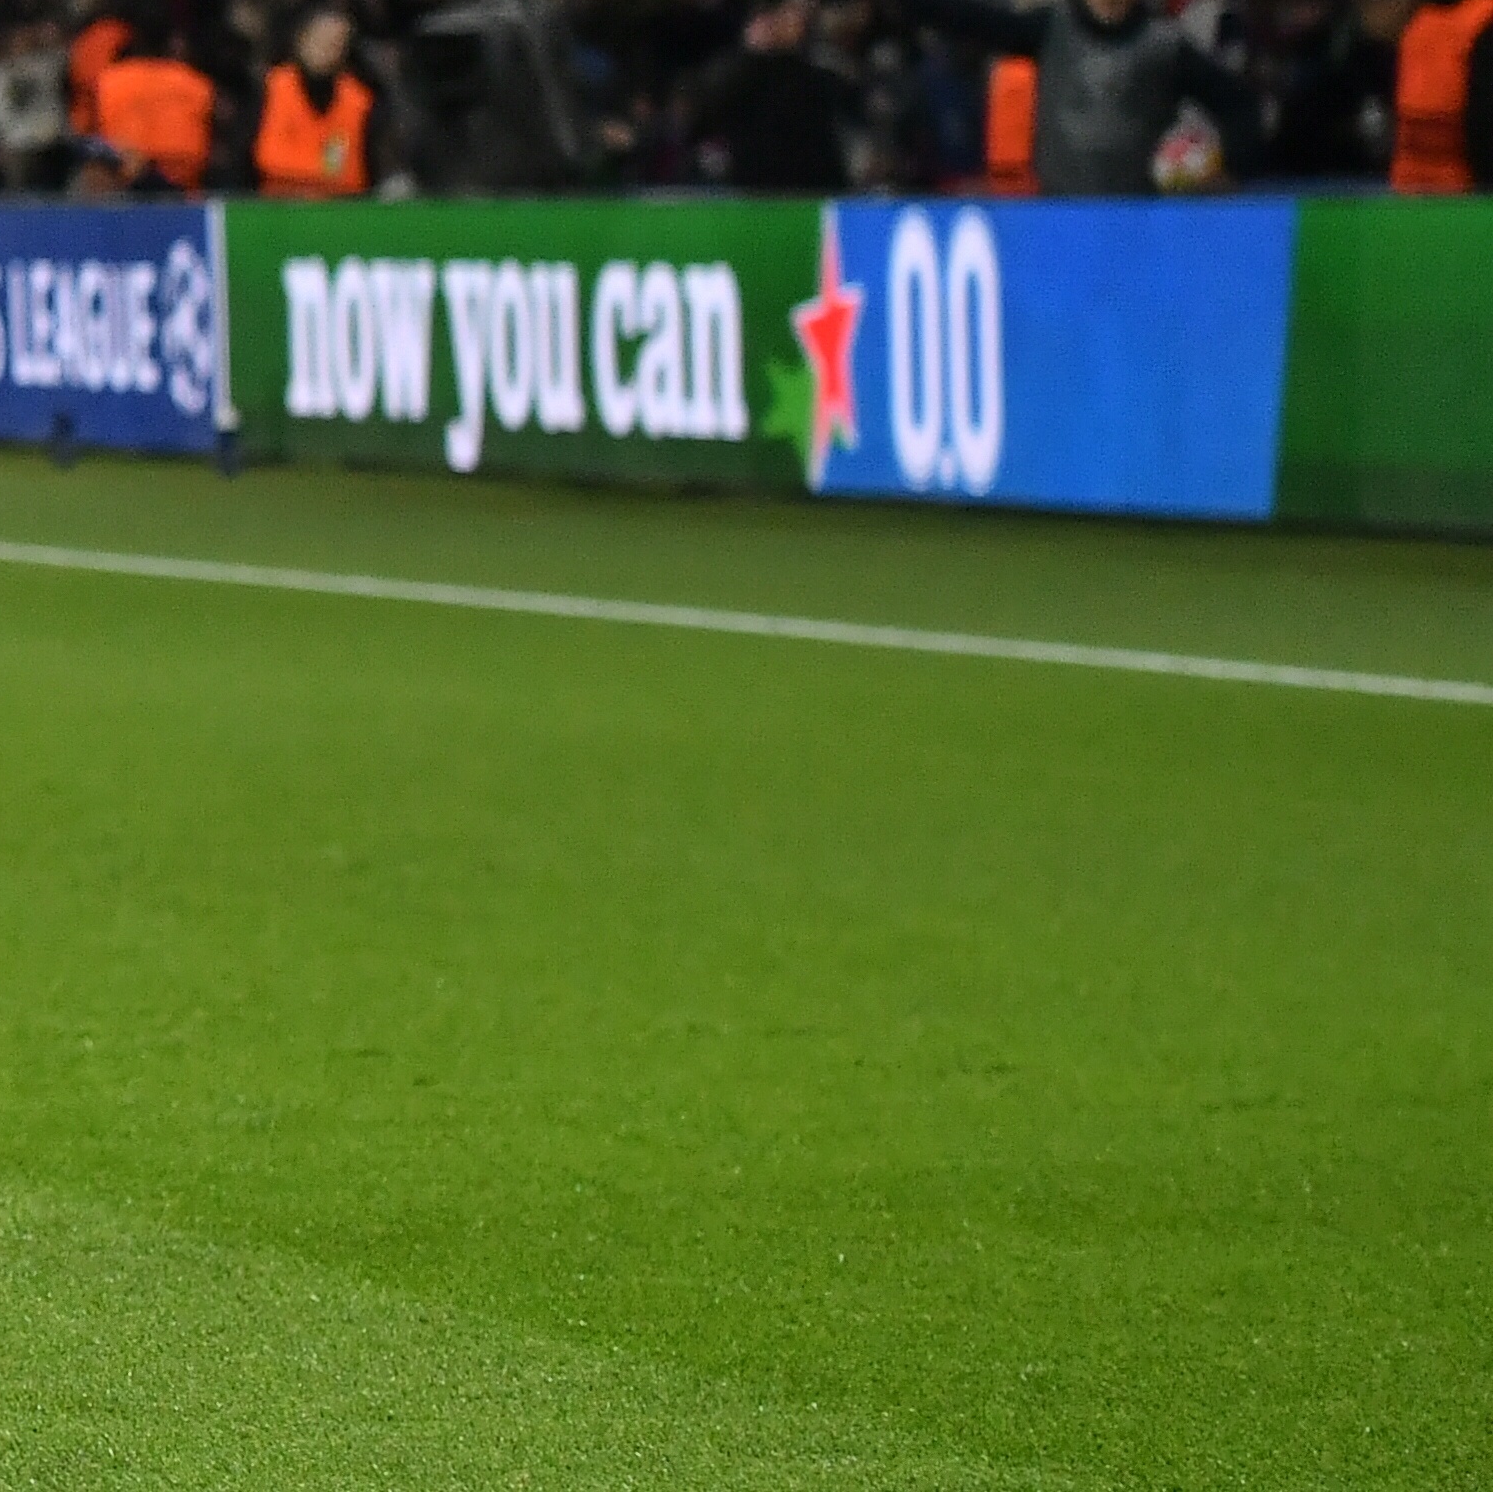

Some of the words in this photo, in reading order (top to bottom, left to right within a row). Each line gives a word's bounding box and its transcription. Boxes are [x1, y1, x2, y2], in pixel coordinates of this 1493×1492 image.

[7, 258, 160, 393] LEAGUE
[283, 256, 436, 422] now
[441, 258, 585, 473] you
[592, 260, 749, 442] can
[887, 205, 1005, 497] 0.0
